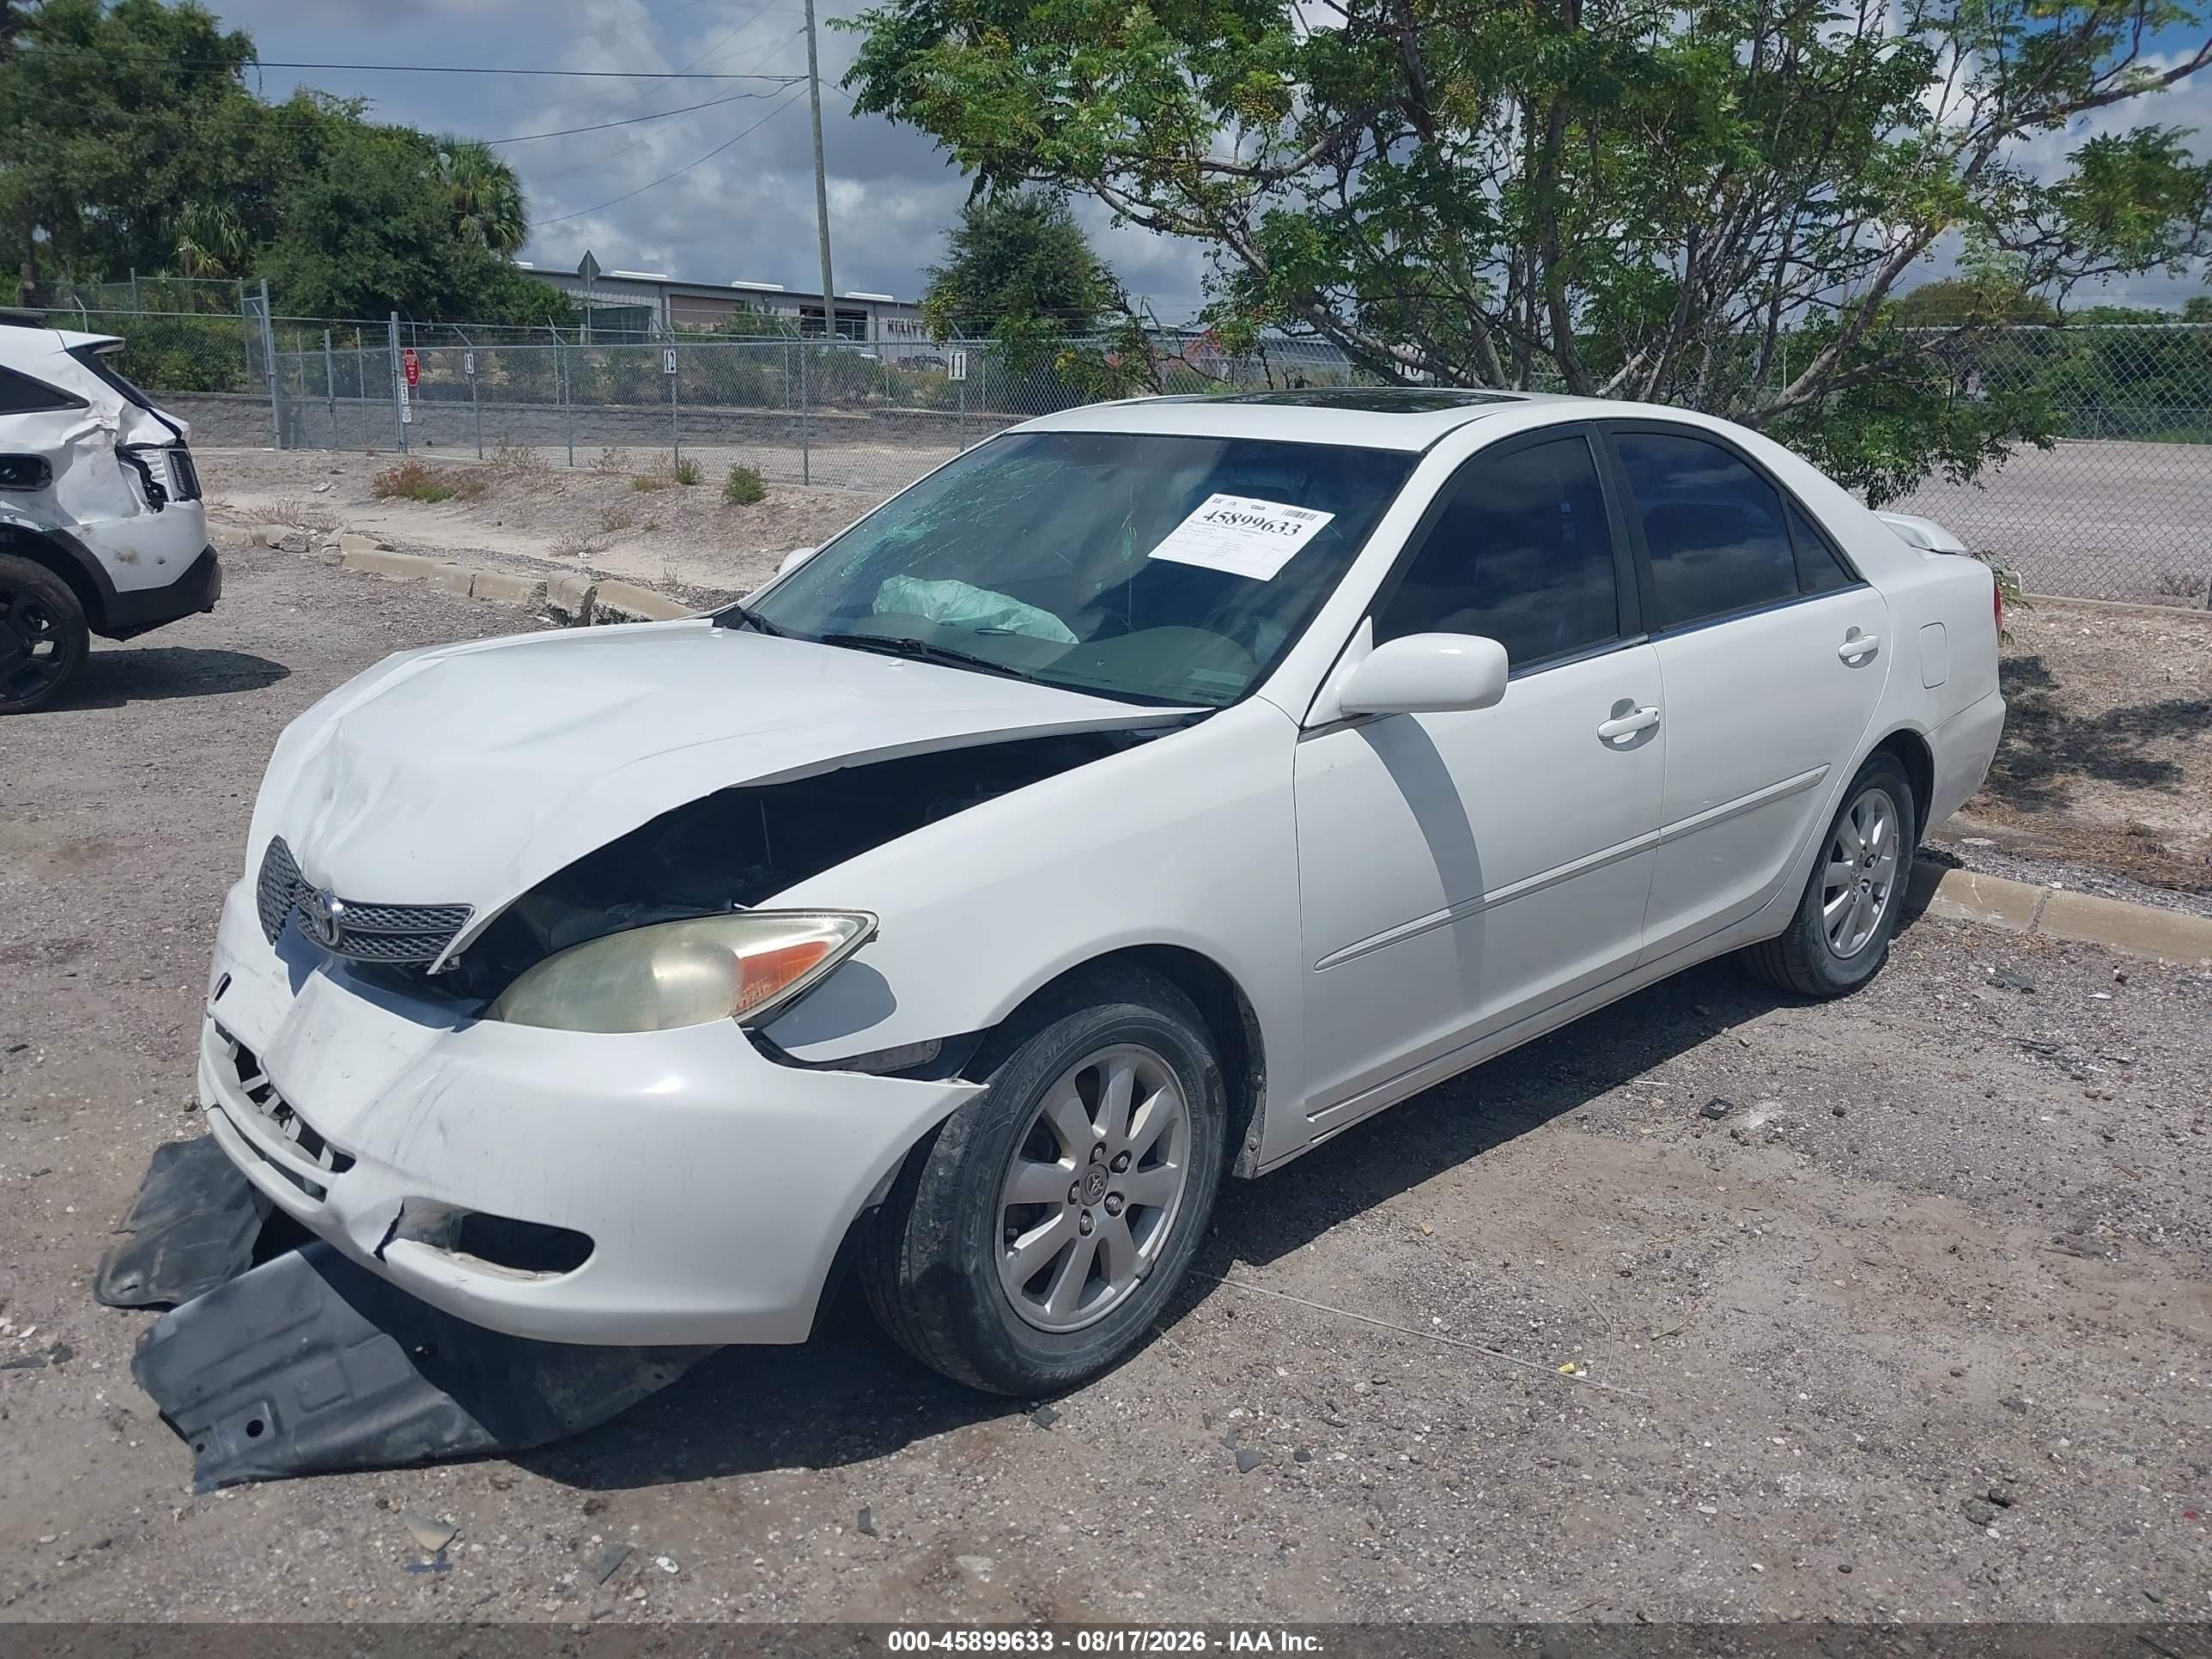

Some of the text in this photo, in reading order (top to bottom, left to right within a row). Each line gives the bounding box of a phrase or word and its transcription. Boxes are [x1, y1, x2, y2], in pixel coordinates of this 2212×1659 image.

[405, 354, 416, 366] STOP
[465, 356, 473, 372] 13
[665, 351, 675, 371] 12
[951, 352, 963, 378] 11
[403, 389, 407, 399] 5
[1203, 510, 1302, 537] 45899633
